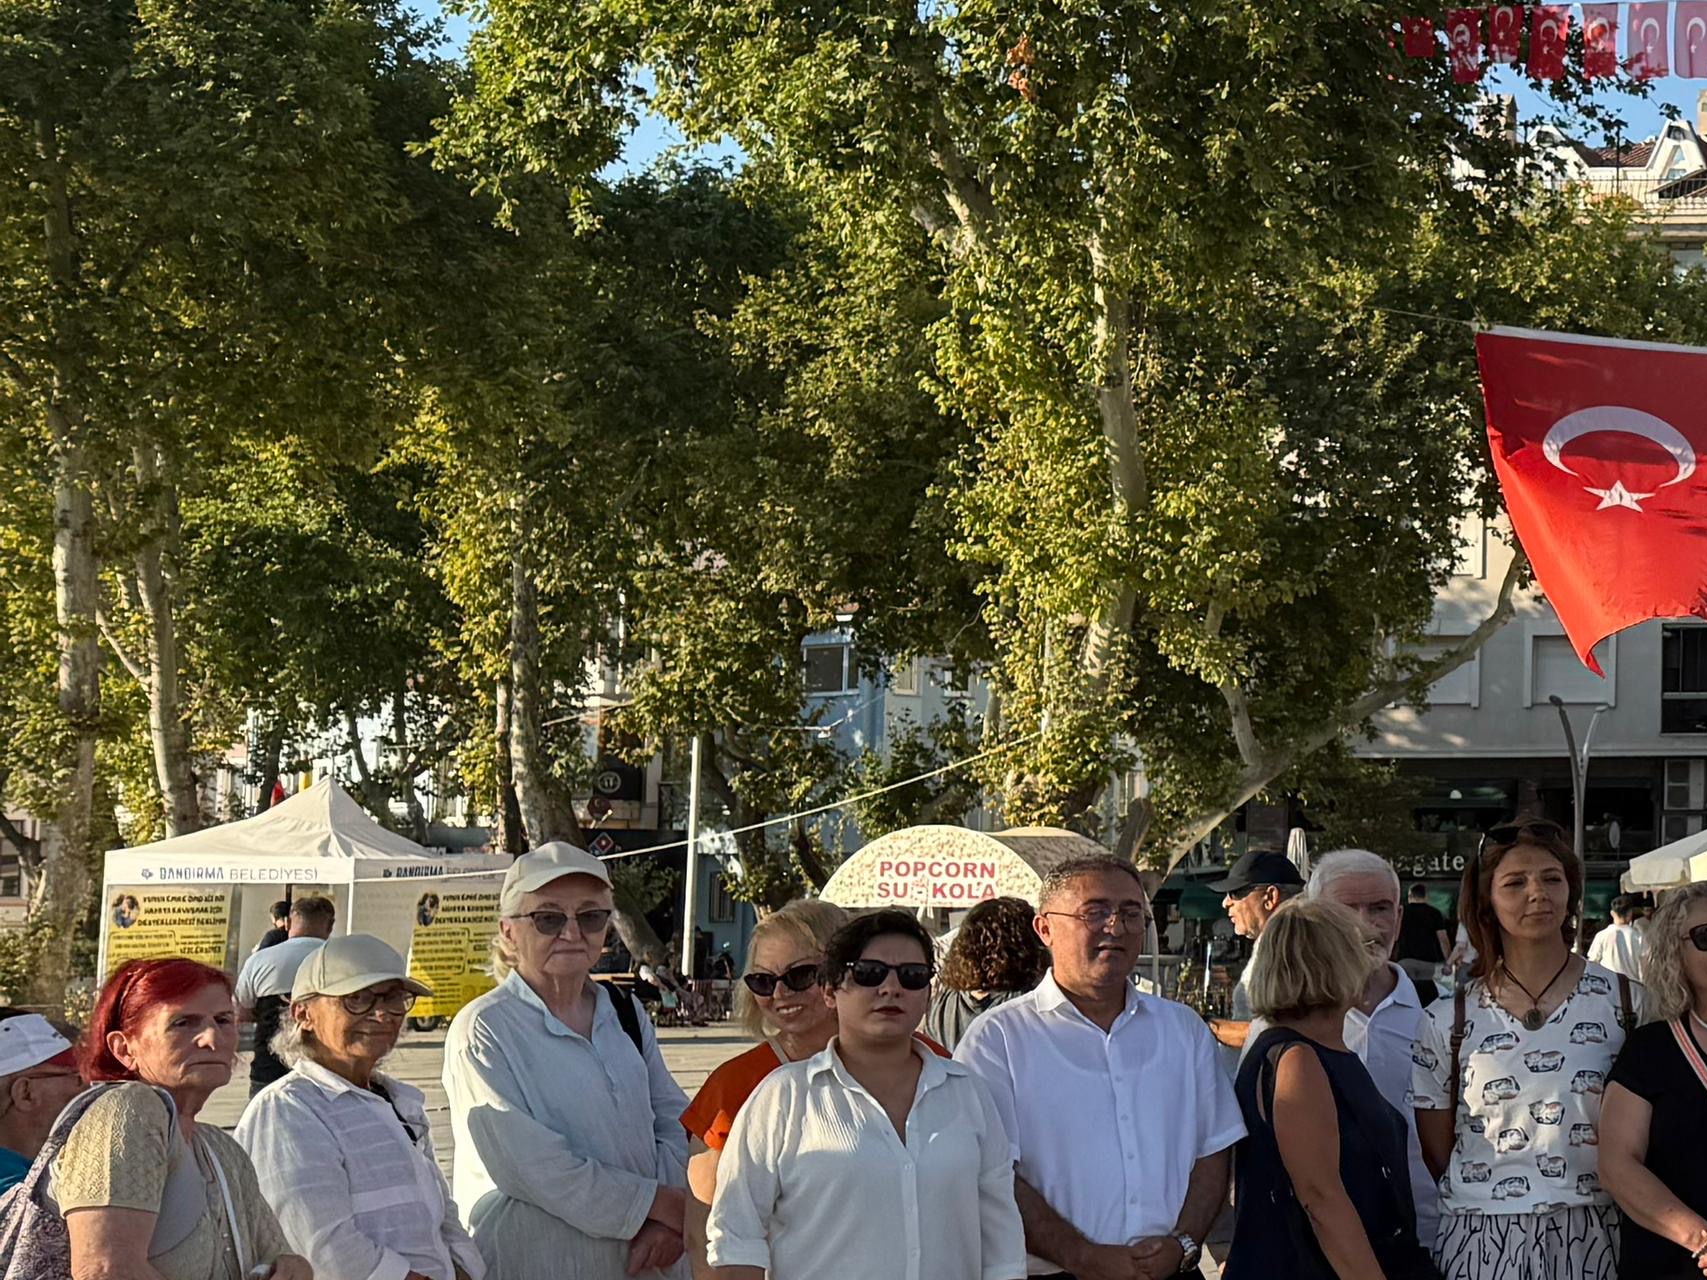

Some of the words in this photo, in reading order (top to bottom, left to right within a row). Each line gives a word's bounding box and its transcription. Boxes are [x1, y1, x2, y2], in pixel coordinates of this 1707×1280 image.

[159, 867, 224, 881] BANDIRMA
[229, 866, 318, 881] BELEDİYESİ
[879, 861, 996, 879] POPCORN
[877, 882, 908, 899] SU
[932, 882, 996, 900] KOLA
